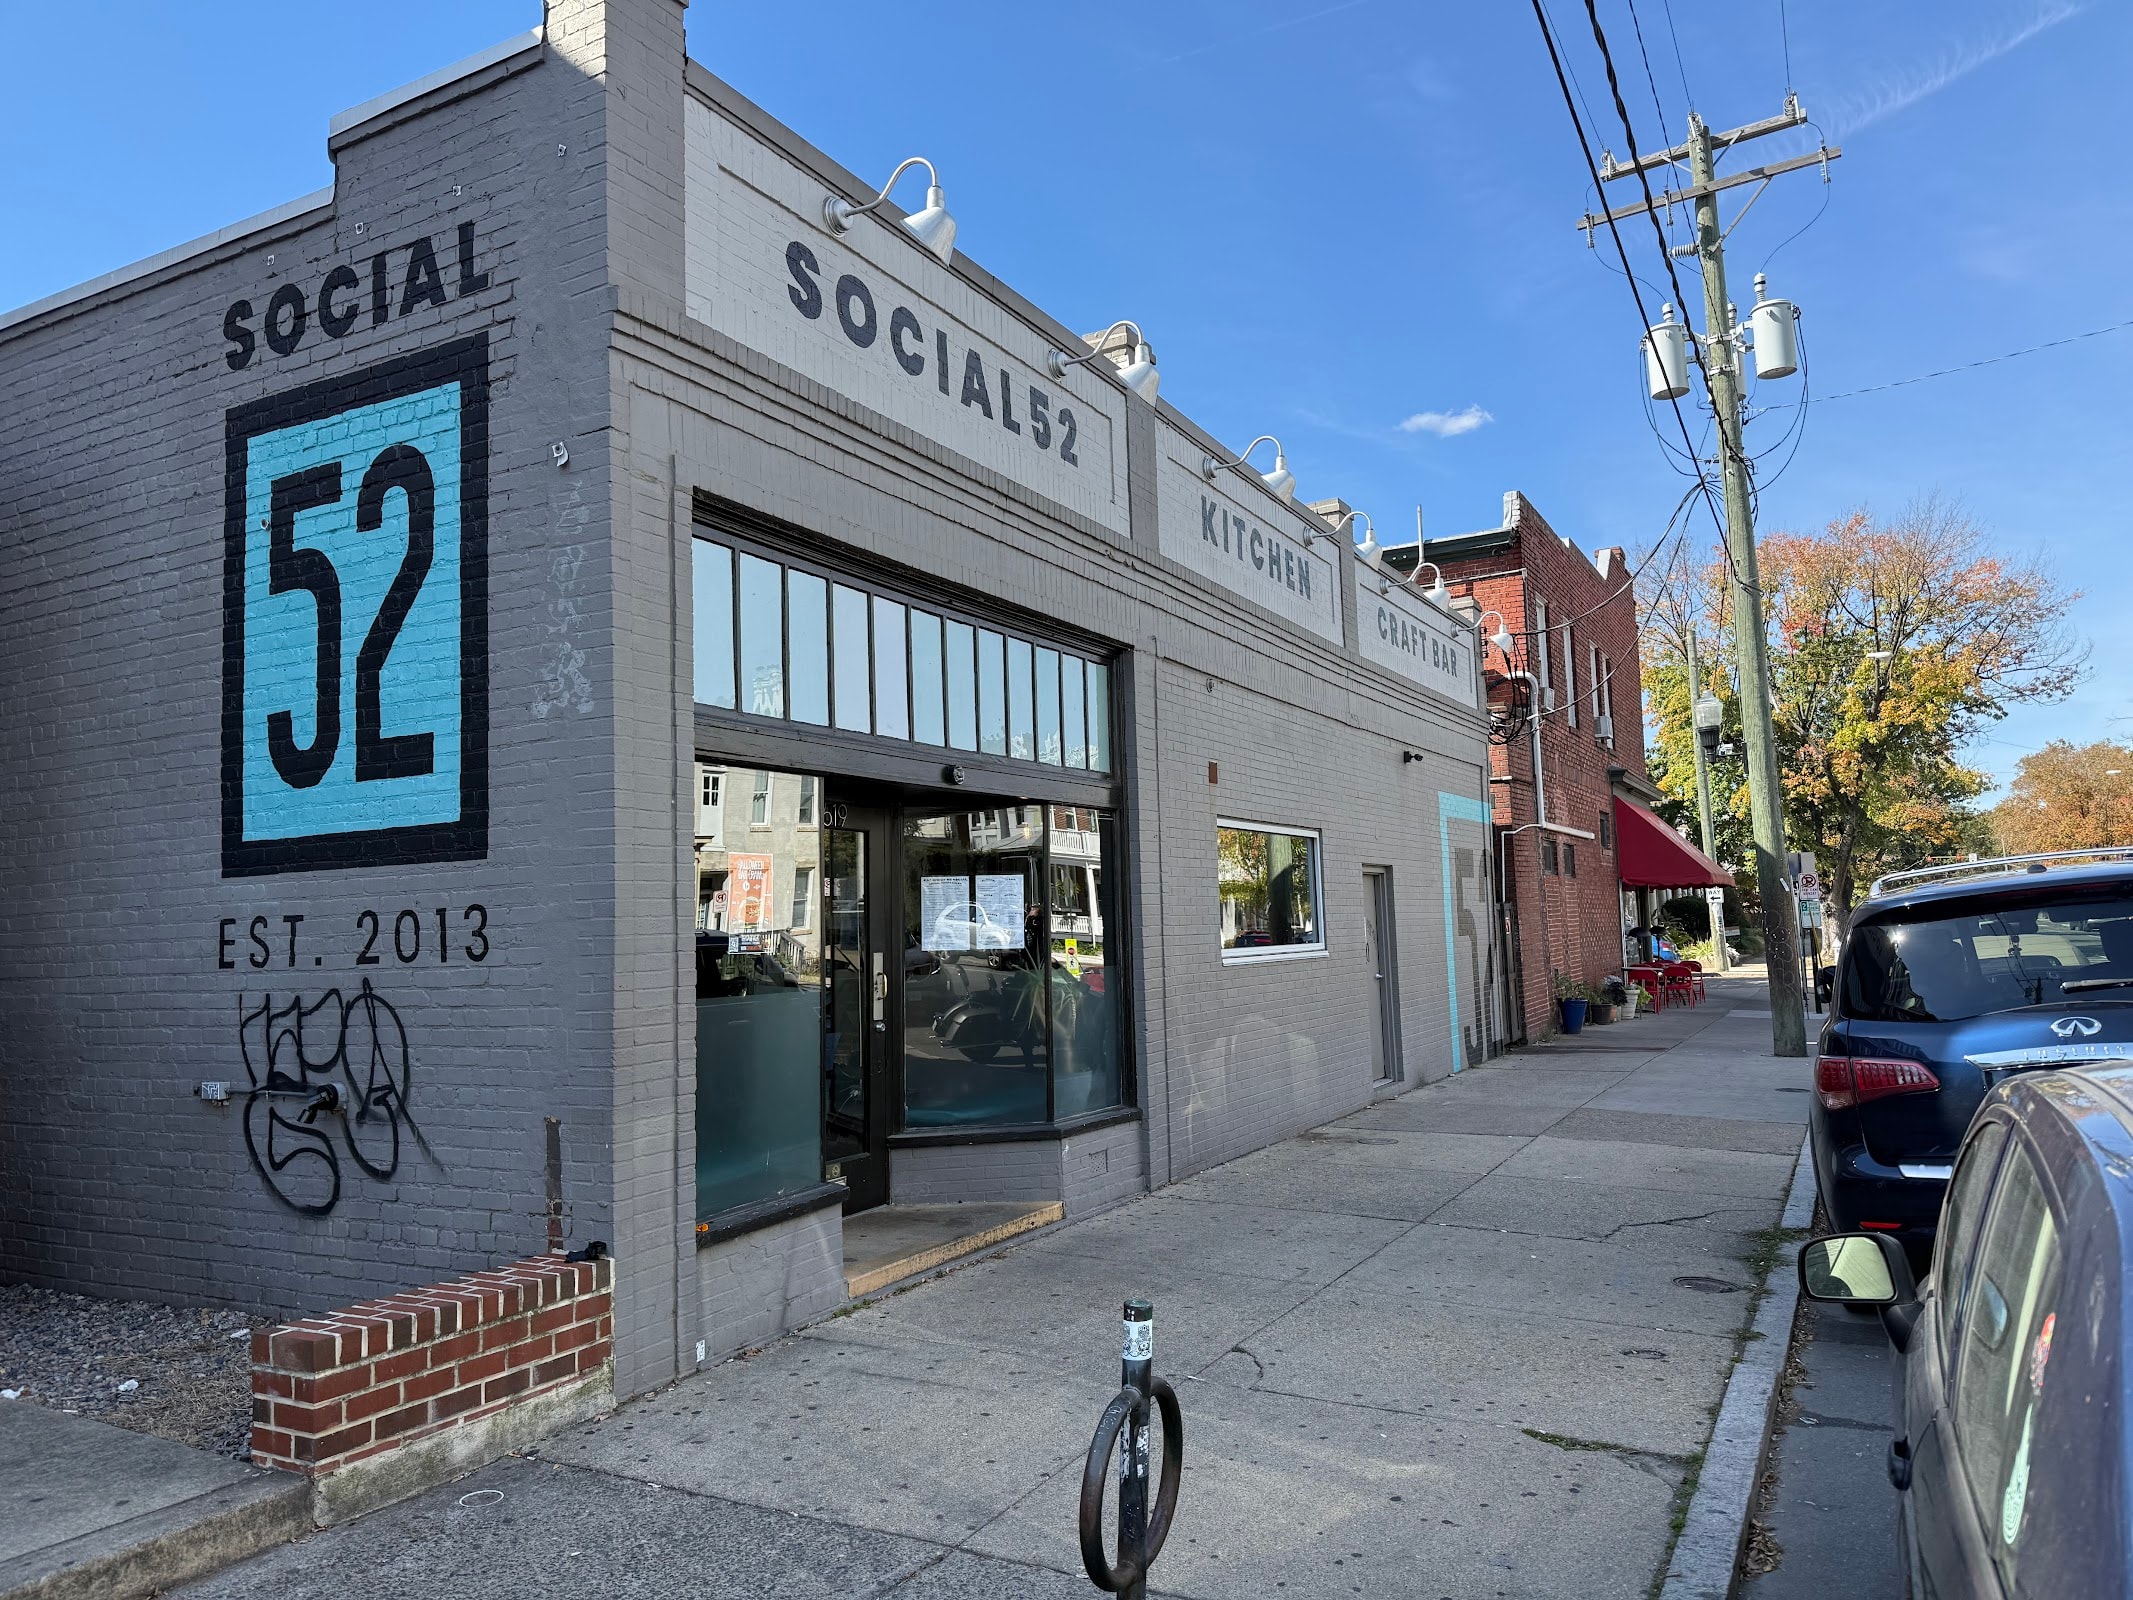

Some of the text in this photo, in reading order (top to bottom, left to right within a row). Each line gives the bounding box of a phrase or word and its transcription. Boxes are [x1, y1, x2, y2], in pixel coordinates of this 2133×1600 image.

[223, 219, 489, 371] SOCIAL
[785, 240, 1078, 468] SOCIAL52
[1201, 494, 1311, 601] KITCHEN
[267, 444, 435, 790] 52
[1377, 606, 1457, 678] CRAFT BAR
[218, 903, 489, 969] EST. 2013
[2022, 1044, 2126, 1060] INFINIT
